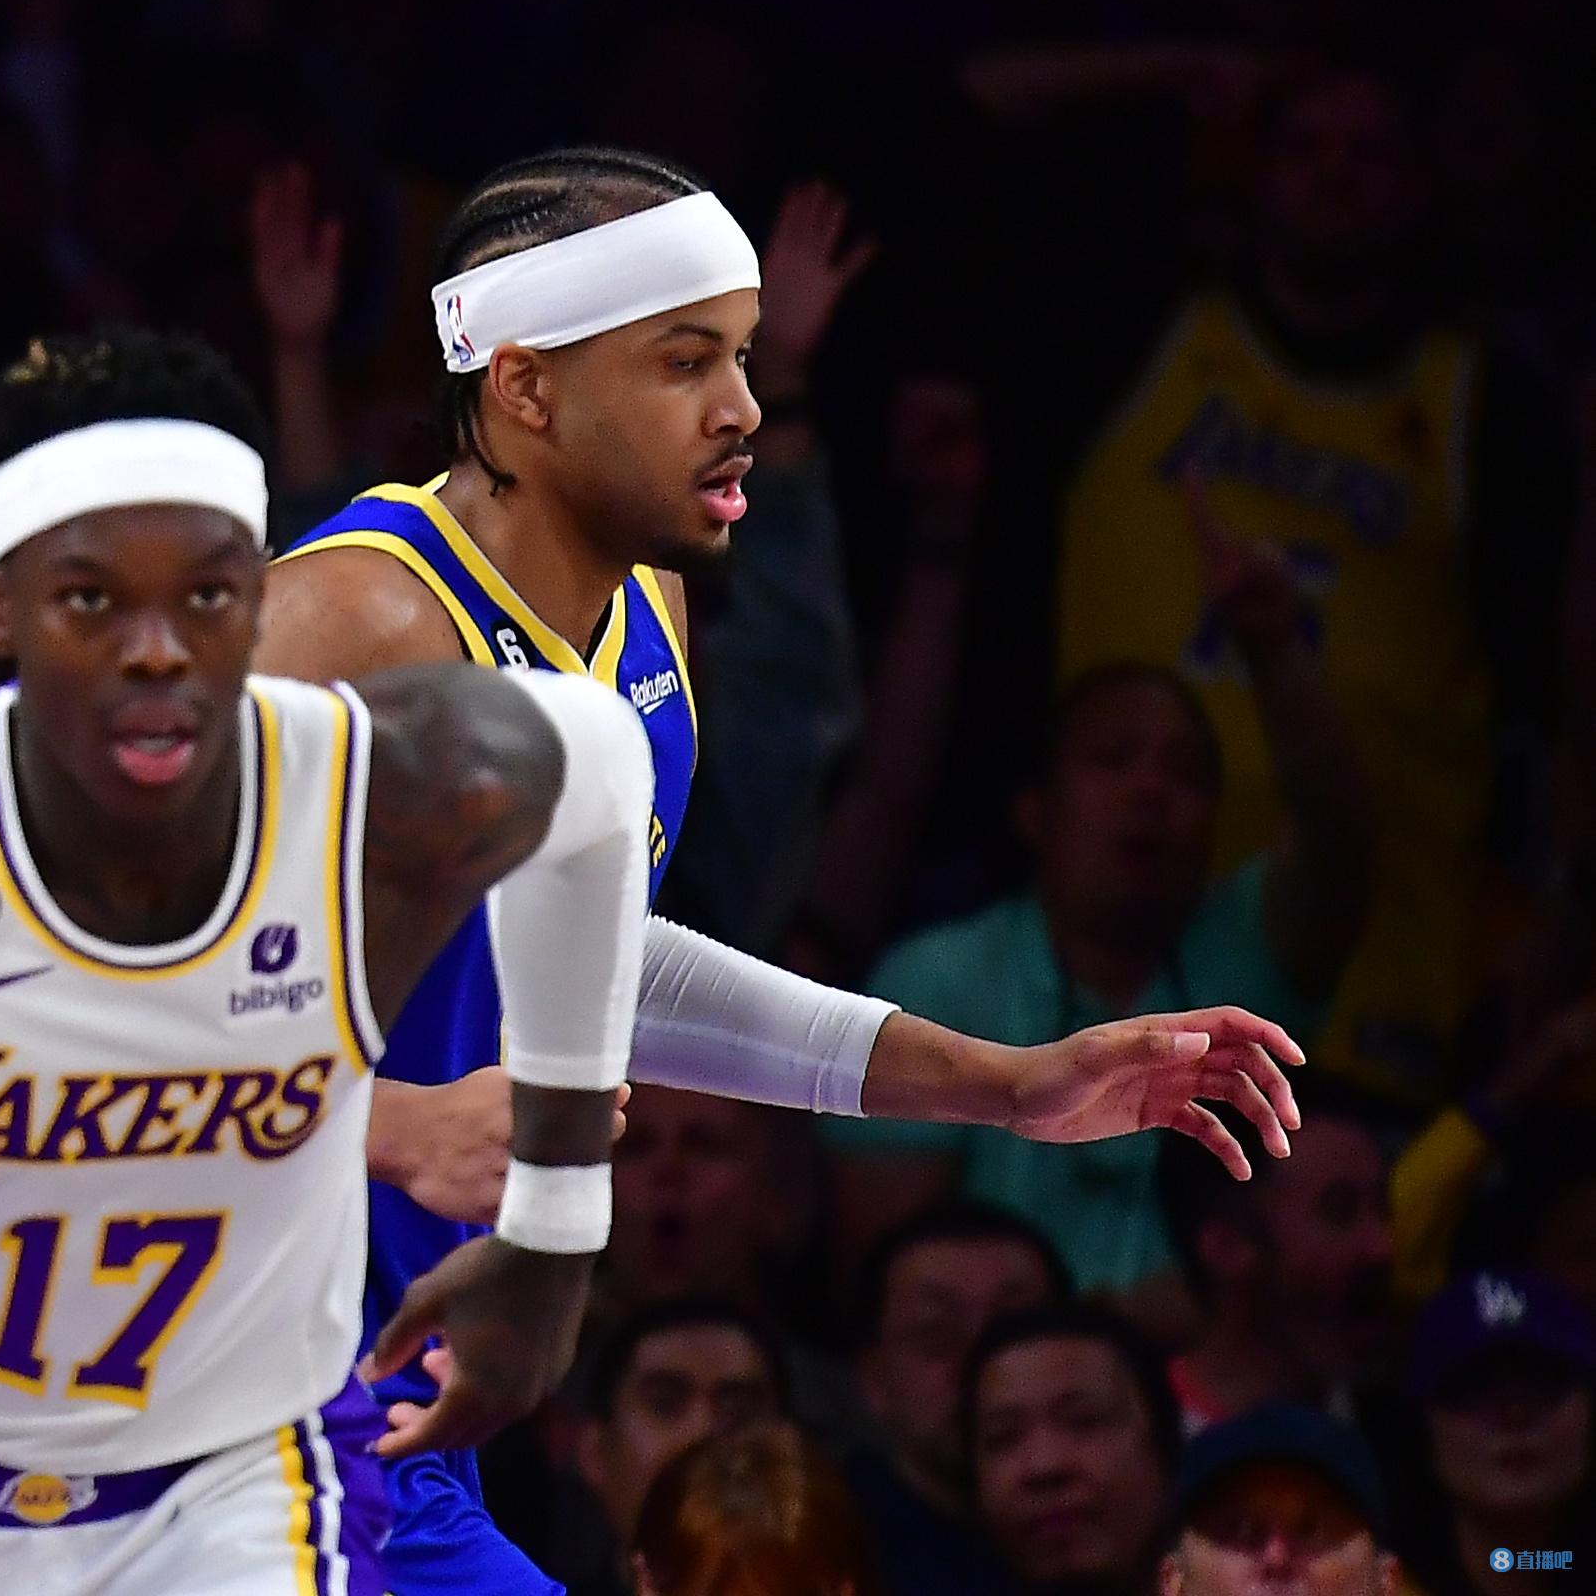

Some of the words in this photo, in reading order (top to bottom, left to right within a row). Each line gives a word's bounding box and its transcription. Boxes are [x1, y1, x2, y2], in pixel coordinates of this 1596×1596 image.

[495, 627, 530, 671] 6
[629, 669, 679, 709] Rakuten
[230, 979, 324, 1016] bibigo
